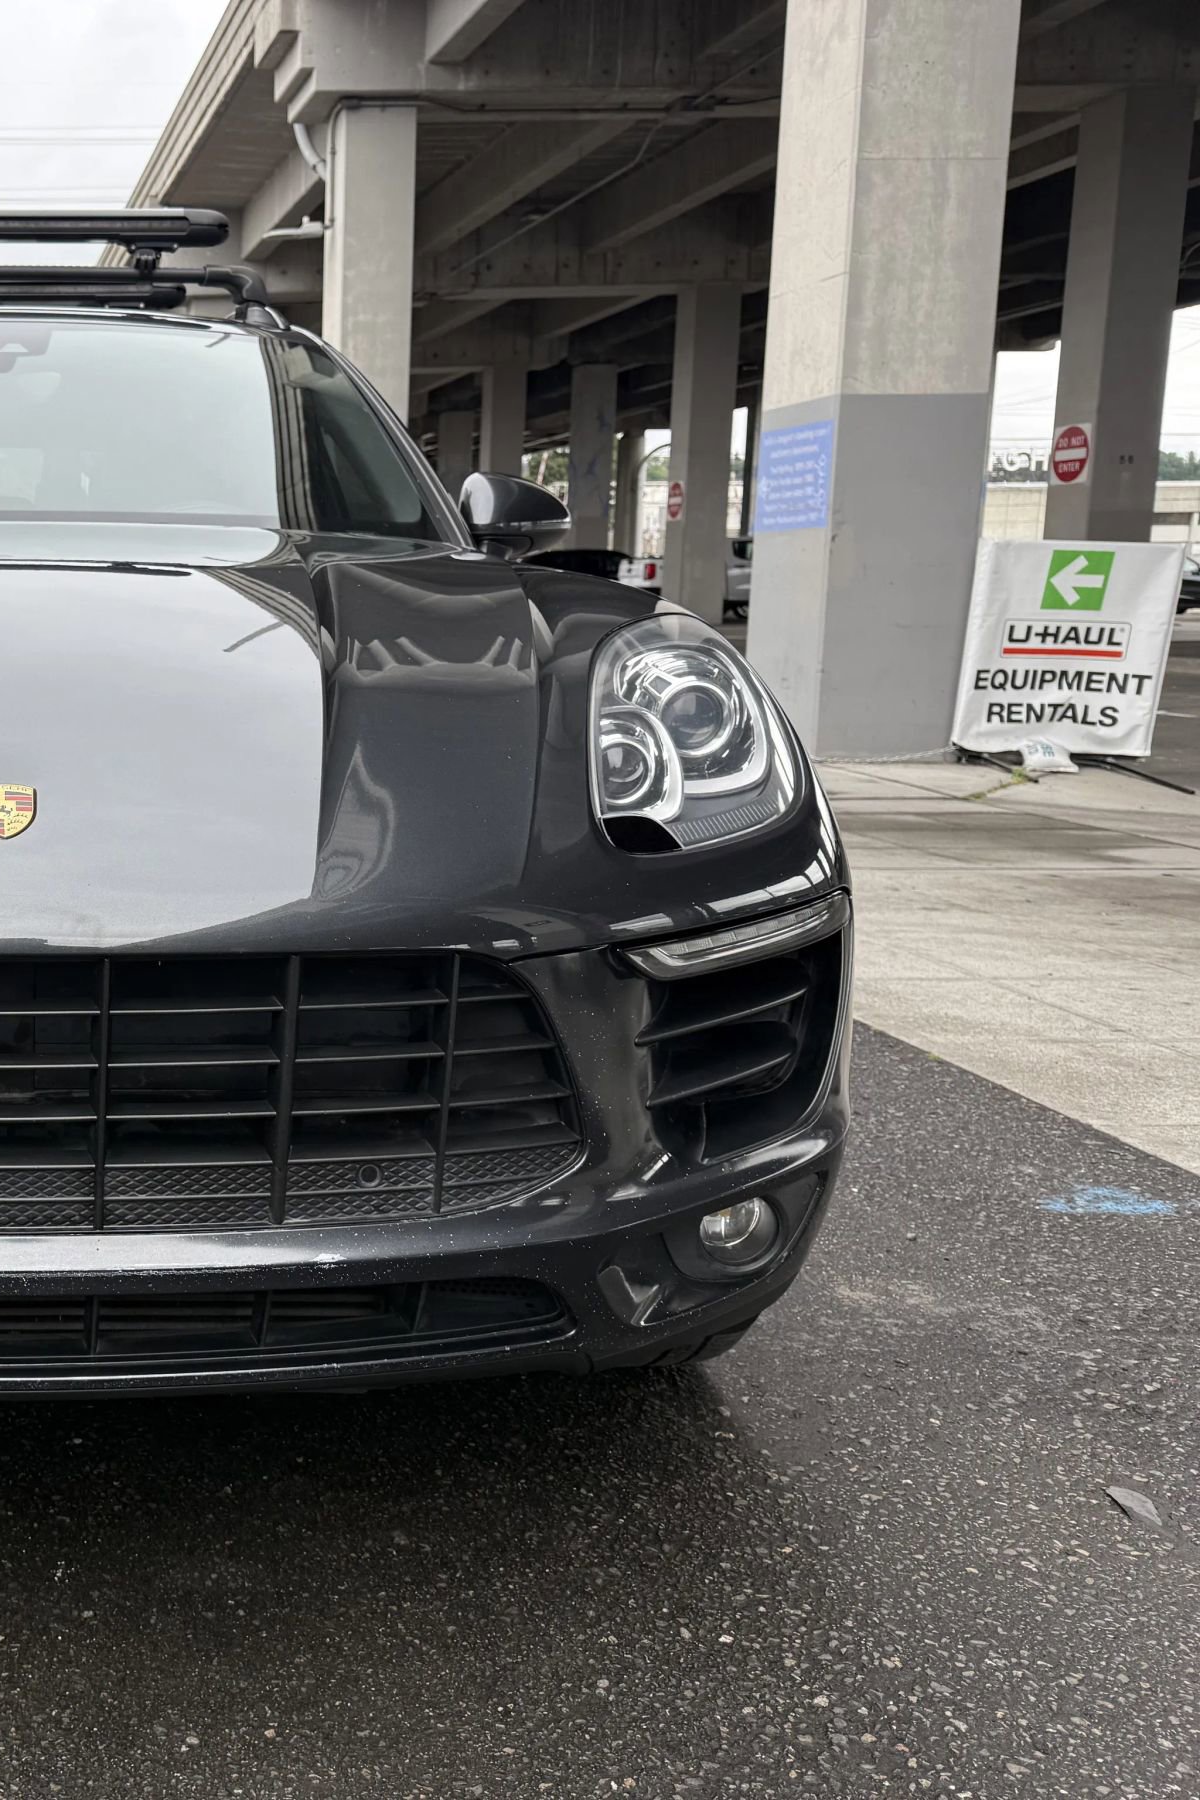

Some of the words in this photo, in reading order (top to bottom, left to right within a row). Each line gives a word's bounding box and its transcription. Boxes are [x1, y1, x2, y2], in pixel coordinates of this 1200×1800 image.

[1058, 438, 1068, 448] DO
[1071, 436, 1085, 446] NOT
[1058, 462, 1080, 473] ENTER
[1008, 624, 1123, 646] U-HAUL
[974, 668, 1152, 696] EQUIPMENT
[986, 702, 1119, 728] RENTALS
